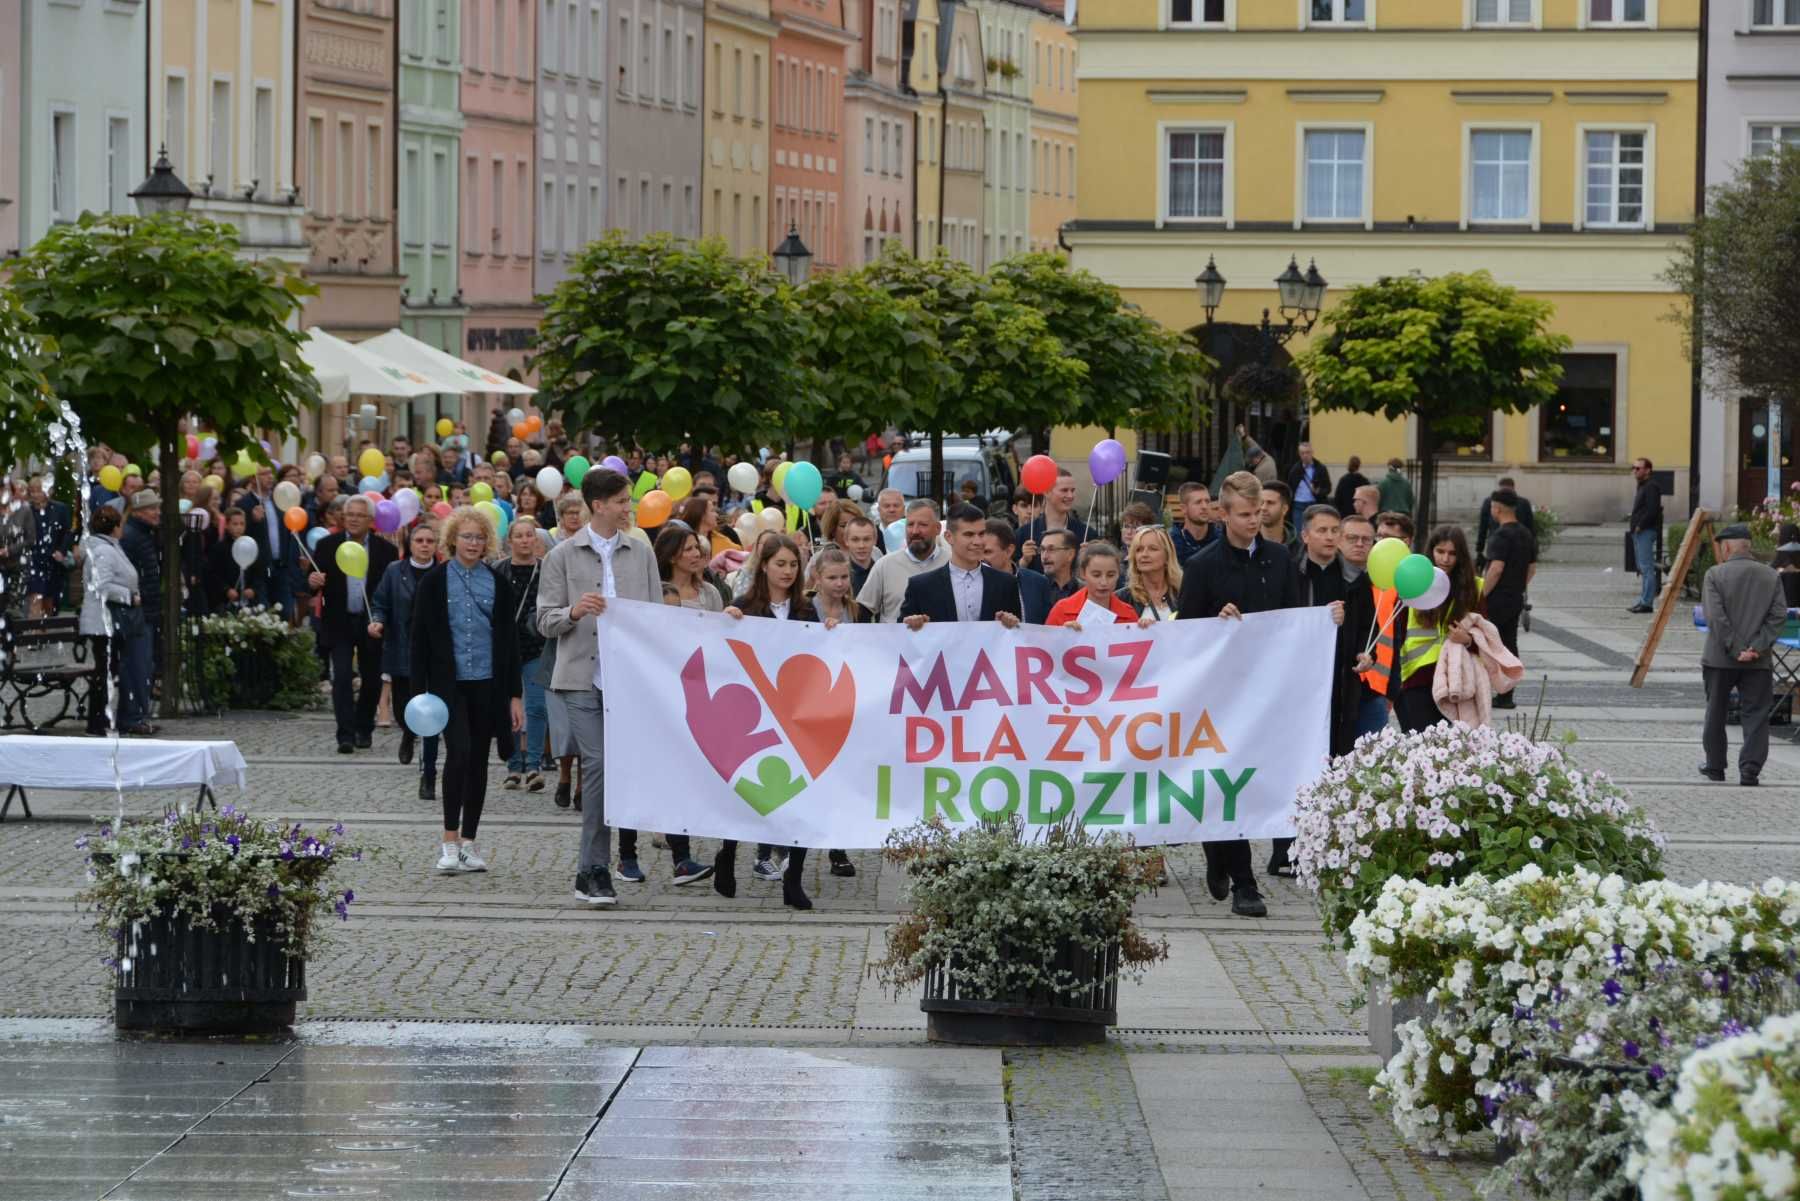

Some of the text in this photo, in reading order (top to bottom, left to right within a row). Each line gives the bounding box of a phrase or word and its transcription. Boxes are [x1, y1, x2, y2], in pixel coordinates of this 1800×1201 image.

[889, 639, 1159, 714] MARSZ
[905, 705, 1228, 763] DLA ŻYCIA
[875, 765, 1257, 825] I RODZINY
